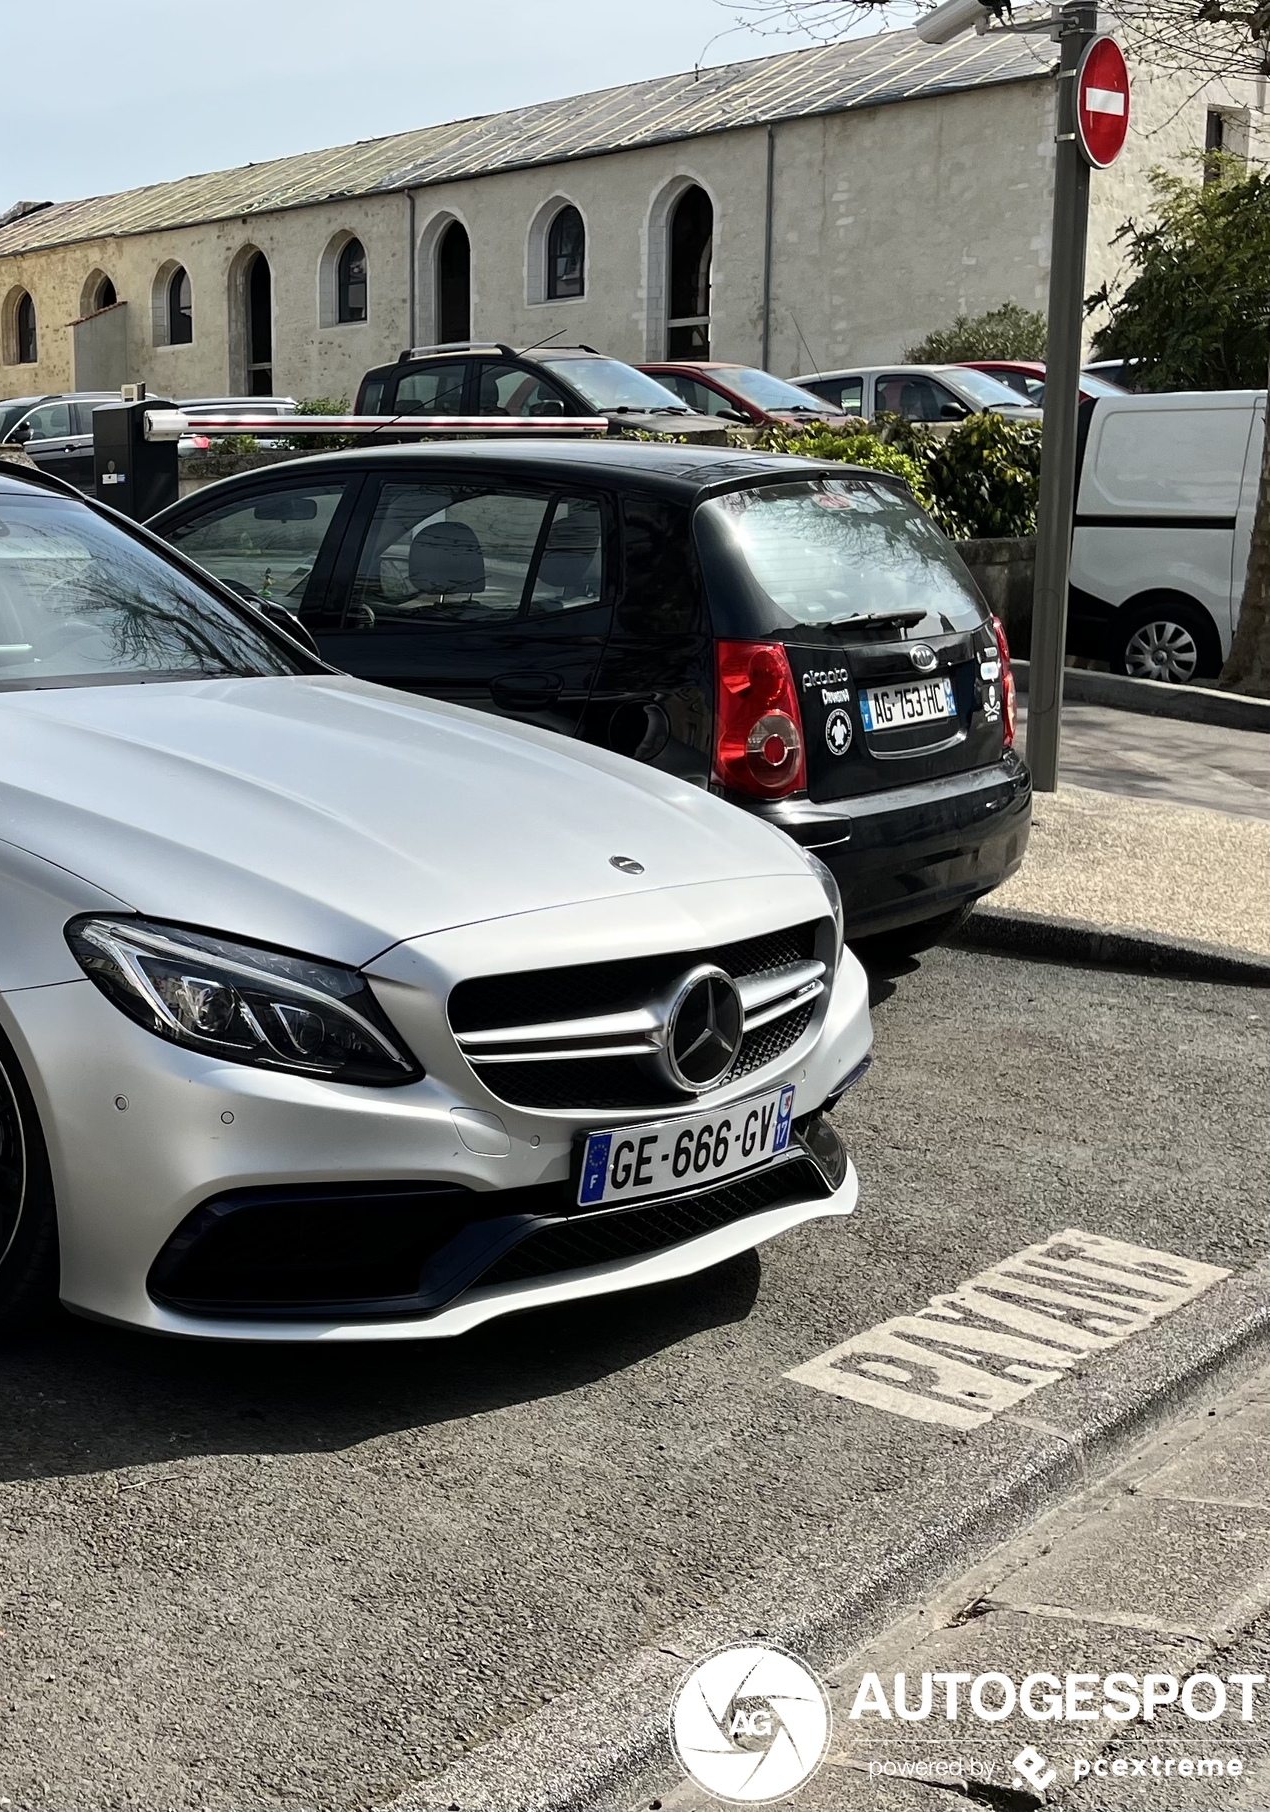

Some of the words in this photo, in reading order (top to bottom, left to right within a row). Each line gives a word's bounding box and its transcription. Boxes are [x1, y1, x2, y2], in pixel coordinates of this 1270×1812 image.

[802, 667, 848, 692] picanto
[873, 684, 944, 725] AG-753-HC
[946, 697, 956, 712] 24
[610, 1101, 775, 1189] GE-666-GV
[774, 1119, 789, 1145] 17
[589, 1174, 598, 1189] F
[830, 1242, 1192, 1412] PAYANT
